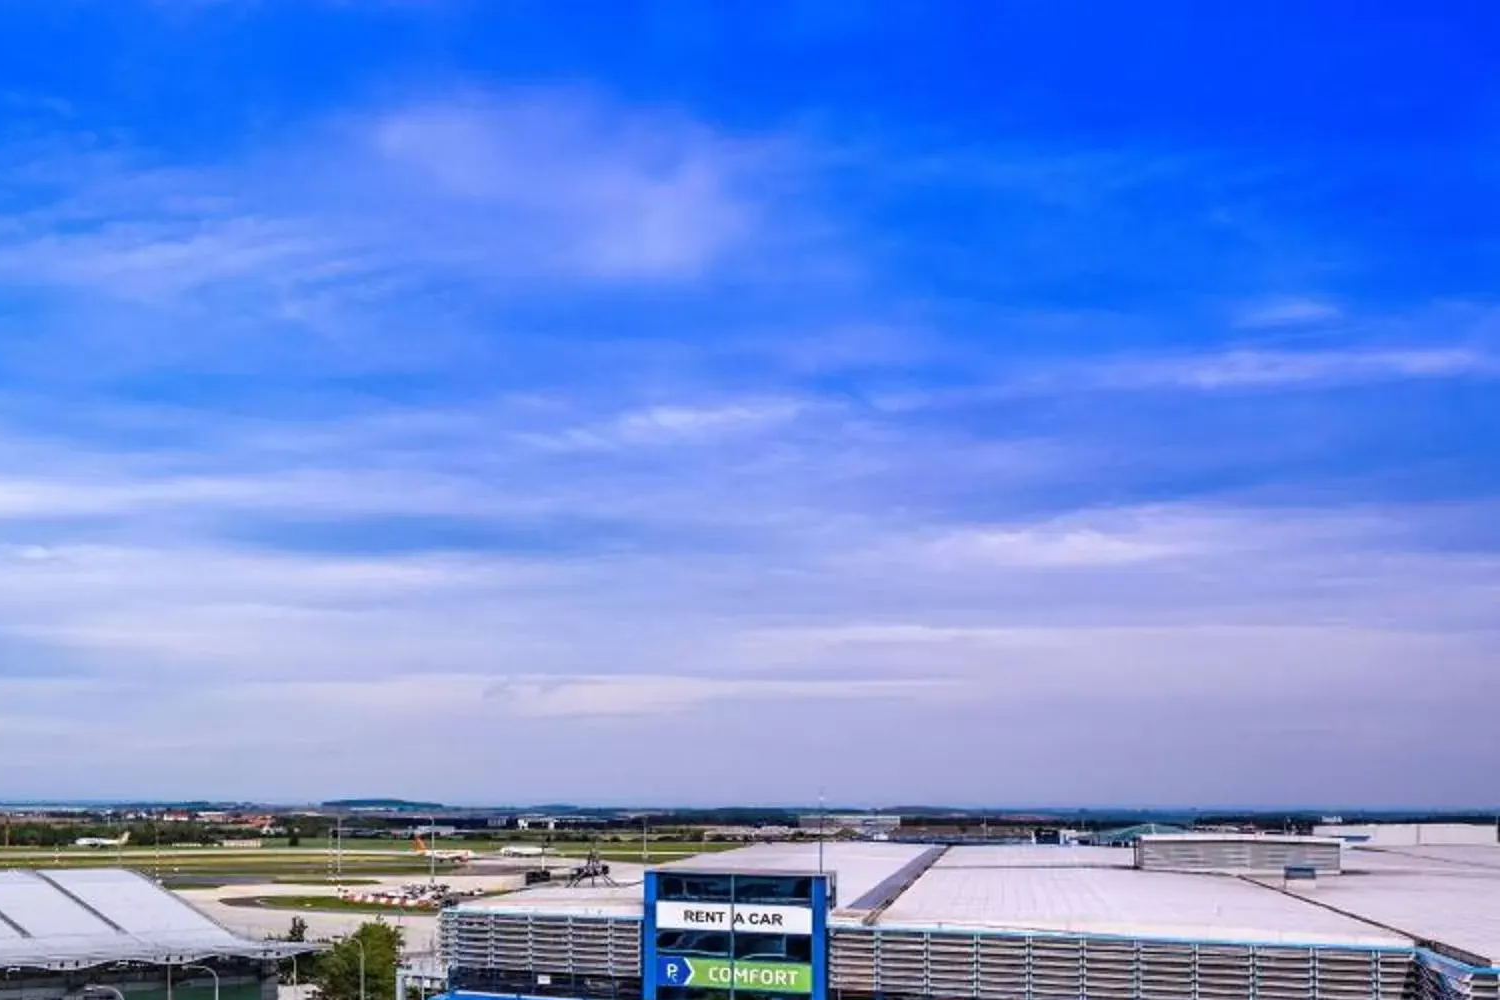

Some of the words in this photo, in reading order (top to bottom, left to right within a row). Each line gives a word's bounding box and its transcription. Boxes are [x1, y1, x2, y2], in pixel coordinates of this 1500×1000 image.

[683, 910, 726, 923] RENT
[733, 913, 744, 924] A
[748, 914, 783, 926] CAR
[708, 967, 799, 985] COMFORT
